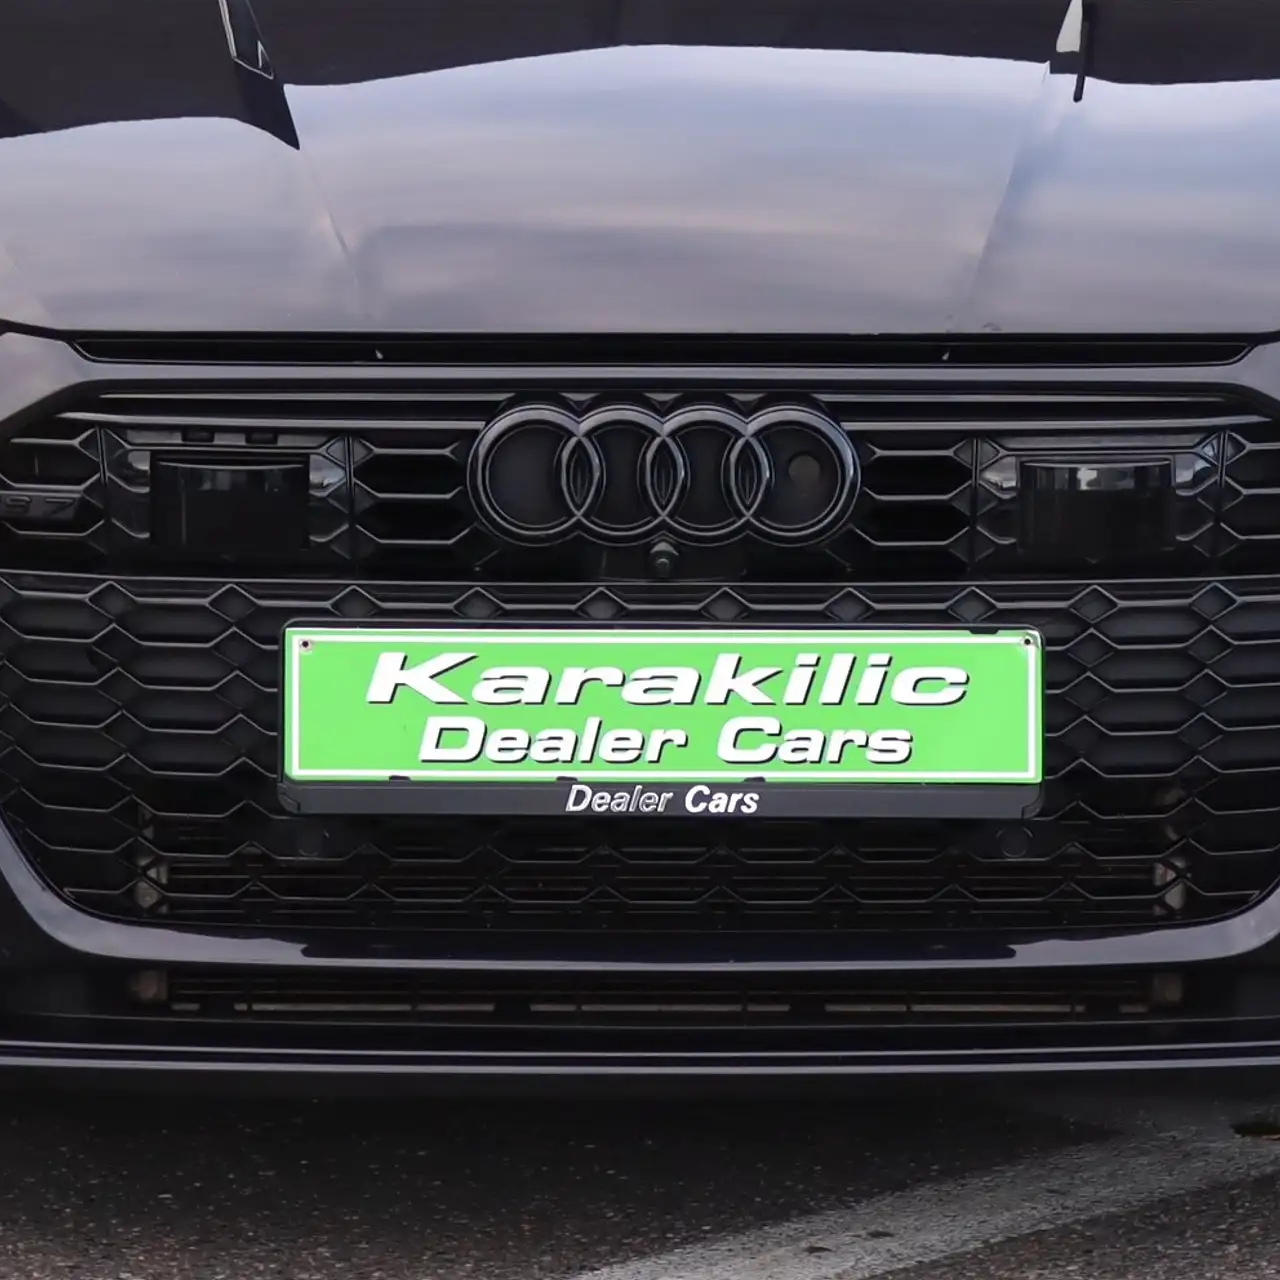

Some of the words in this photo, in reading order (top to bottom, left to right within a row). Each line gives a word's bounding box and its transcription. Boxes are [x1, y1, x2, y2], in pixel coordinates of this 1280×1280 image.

[366, 651, 970, 706] Karakilic
[418, 715, 688, 763] Dealer
[716, 715, 914, 764] Cars
[565, 783, 673, 813] Dealer
[684, 784, 760, 814] Cars
